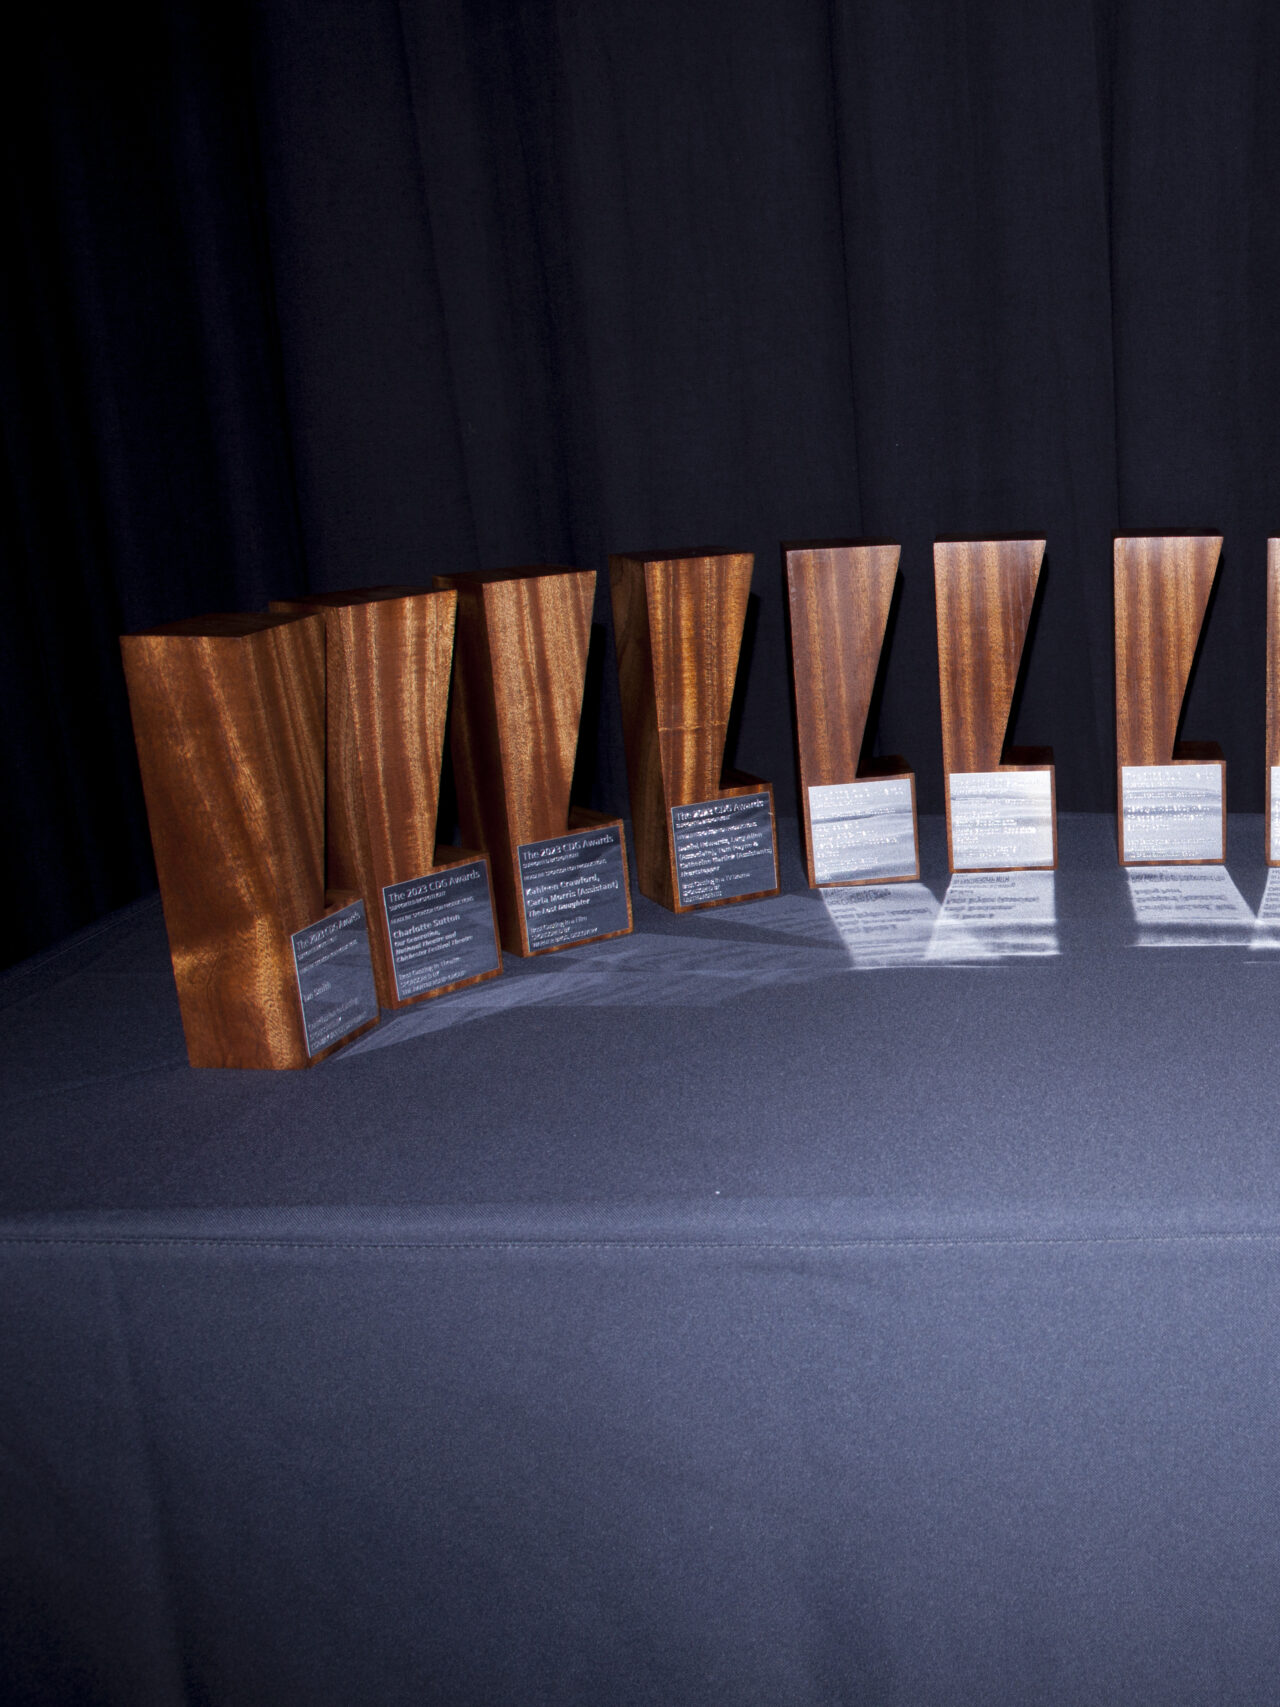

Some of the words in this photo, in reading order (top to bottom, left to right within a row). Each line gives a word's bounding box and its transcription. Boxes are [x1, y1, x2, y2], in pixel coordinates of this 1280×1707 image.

[733, 799, 763, 811] Awards
[523, 851, 539, 860] The
[541, 846, 561, 856] 2023
[562, 841, 581, 850] CDG
[582, 834, 613, 847] Awards
[388, 892, 405, 902] The
[407, 885, 427, 897] 2023
[429, 879, 447, 890] CDG
[449, 870, 480, 885] Awards
[526, 884, 558, 895] Kahleen
[560, 874, 599, 887] Crawford,
[527, 897, 548, 907] Carla
[550, 890, 576, 901] Morris
[577, 880, 618, 895] (Assistant)
[393, 923, 431, 938] Charlotte
[433, 914, 460, 926] Sutton
